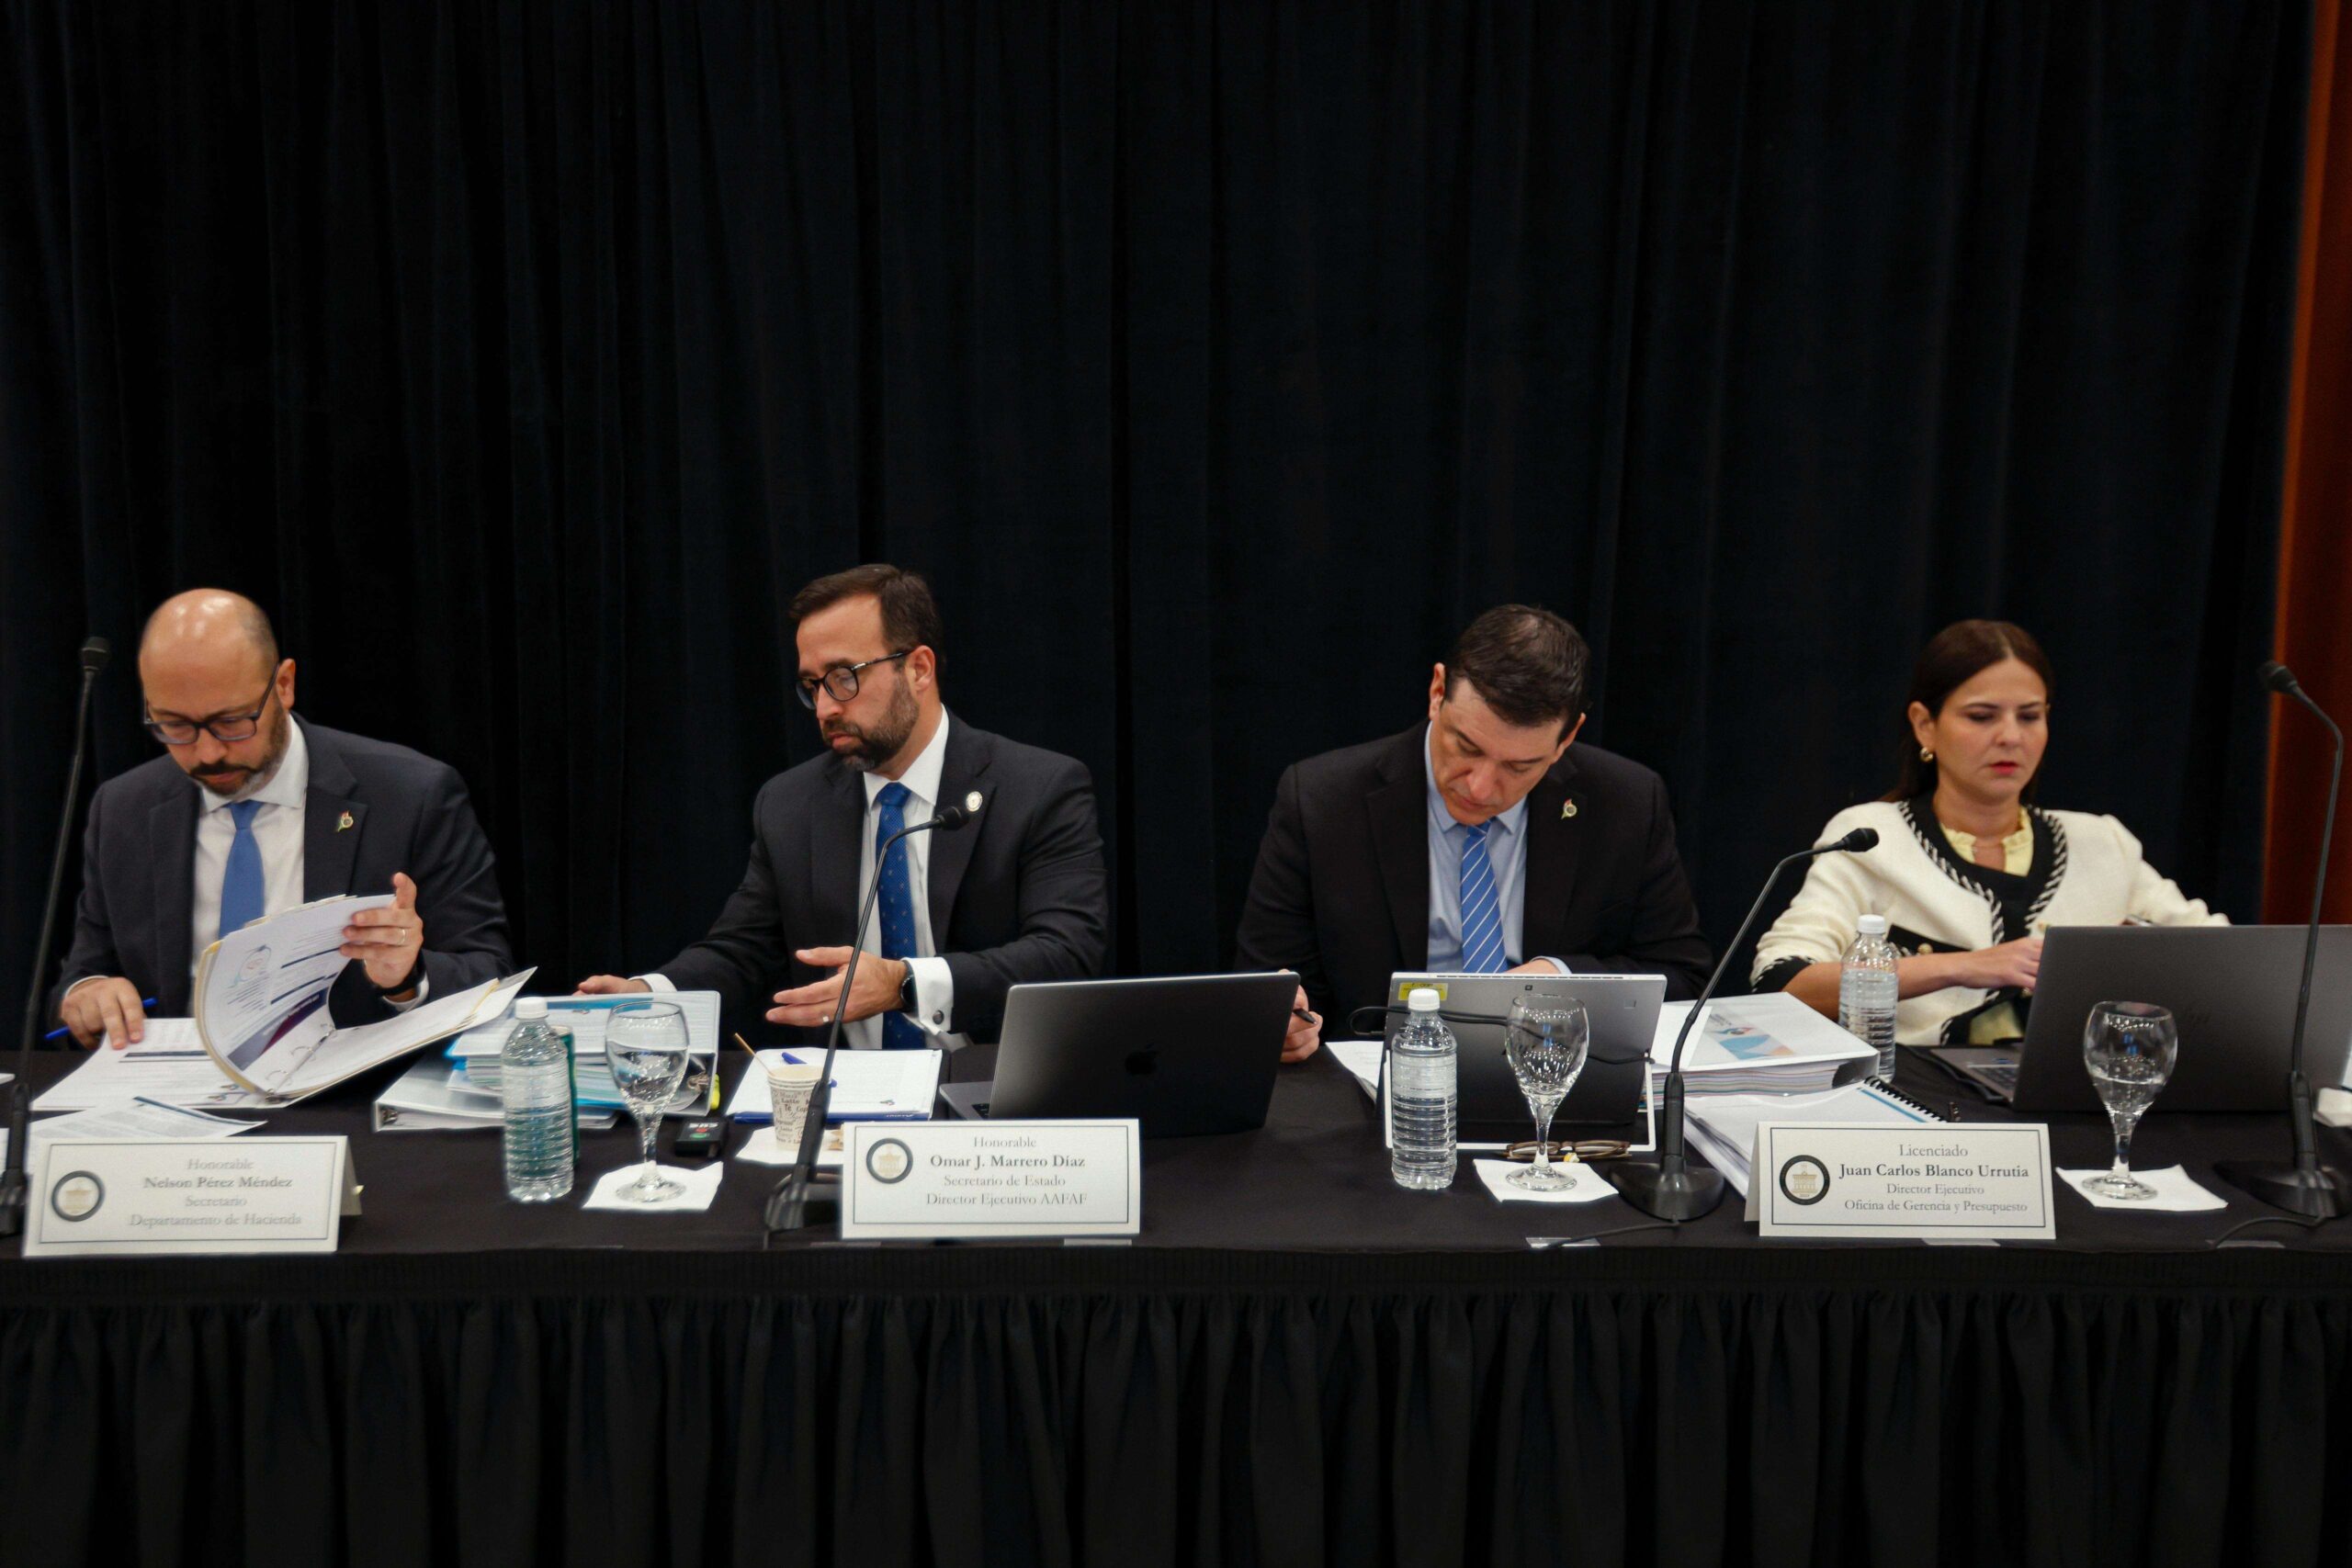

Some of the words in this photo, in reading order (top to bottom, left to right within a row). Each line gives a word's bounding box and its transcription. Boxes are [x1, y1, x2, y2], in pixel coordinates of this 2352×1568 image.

[974, 1135, 1037, 1147] Honorable
[1899, 1144, 1969, 1156] Licenciado
[187, 1157, 254, 1170] Honorable
[930, 1154, 971, 1167] Omar
[974, 1154, 986, 1170] J.
[990, 1154, 1048, 1167] Marrero
[1052, 1154, 1086, 1167] Díaz
[1838, 1163, 1871, 1179] Juan
[1876, 1163, 1921, 1177] Carlos
[1925, 1164, 1973, 1177] Blanco
[1977, 1165, 2030, 1178] Urrutia
[143, 1176, 193, 1189] Nelson
[197, 1176, 235, 1189] Pérez
[238, 1176, 293, 1189] Méndez
[944, 1174, 1002, 1186] Secretario
[1006, 1175, 1021, 1186] de
[1024, 1174, 1066, 1186] Estado
[1886, 1183, 1931, 1194] Director
[1935, 1183, 1984, 1197] Ejecutivo
[185, 1195, 248, 1207] Secretario
[927, 1192, 978, 1205] Director
[981, 1192, 1036, 1208] Ejecutivo
[1040, 1192, 1088, 1205] AAFAF
[1844, 1199, 1883, 1211] Oficina
[1887, 1199, 1901, 1211] de
[1904, 1200, 1951, 1212] Gerencia
[1953, 1202, 1961, 1214] y
[1963, 1200, 2028, 1215] Presupuesto
[130, 1213, 221, 1229] Departamento
[224, 1213, 241, 1225] de
[244, 1213, 302, 1225] Hacienda
